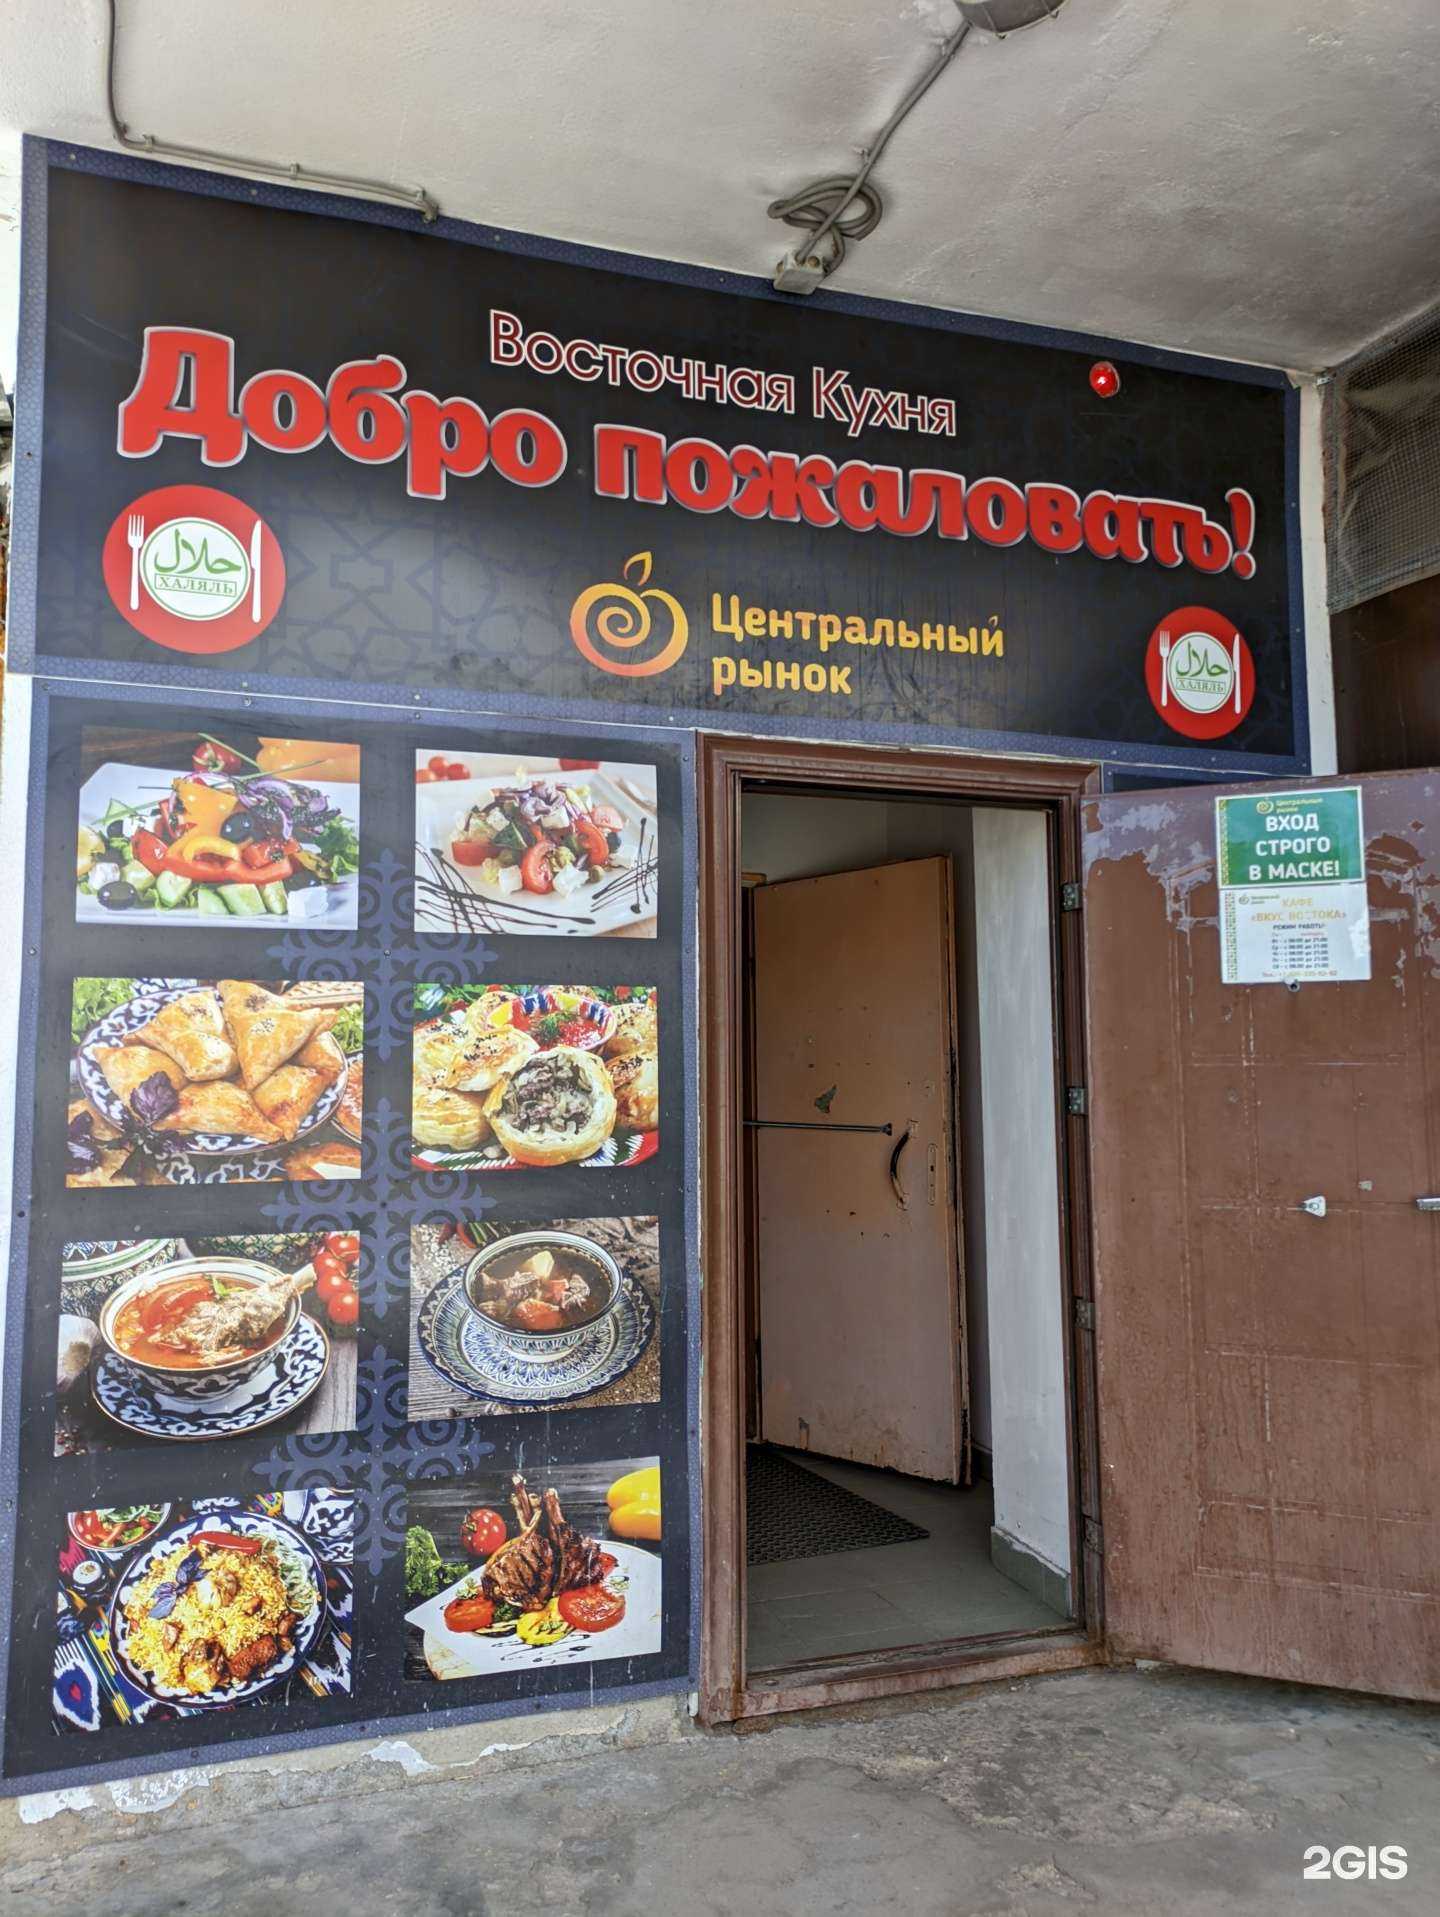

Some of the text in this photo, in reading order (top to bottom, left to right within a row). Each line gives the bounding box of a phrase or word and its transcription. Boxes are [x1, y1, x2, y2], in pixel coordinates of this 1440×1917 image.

[489, 308, 957, 437] Восточная Кухня
[117, 325, 1256, 580] Добро пожаловать!
[153, 528, 242, 575] حلال
[159, 576, 233, 594] ХАЛЯЛЬ
[711, 592, 1005, 657] Центральный
[711, 654, 852, 695] рынок
[1175, 639, 1228, 678] حلال
[1265, 813, 1320, 833] ВХОД
[1255, 836, 1331, 857] СТРОГО
[1248, 860, 1340, 881] В МАСКЕ!
